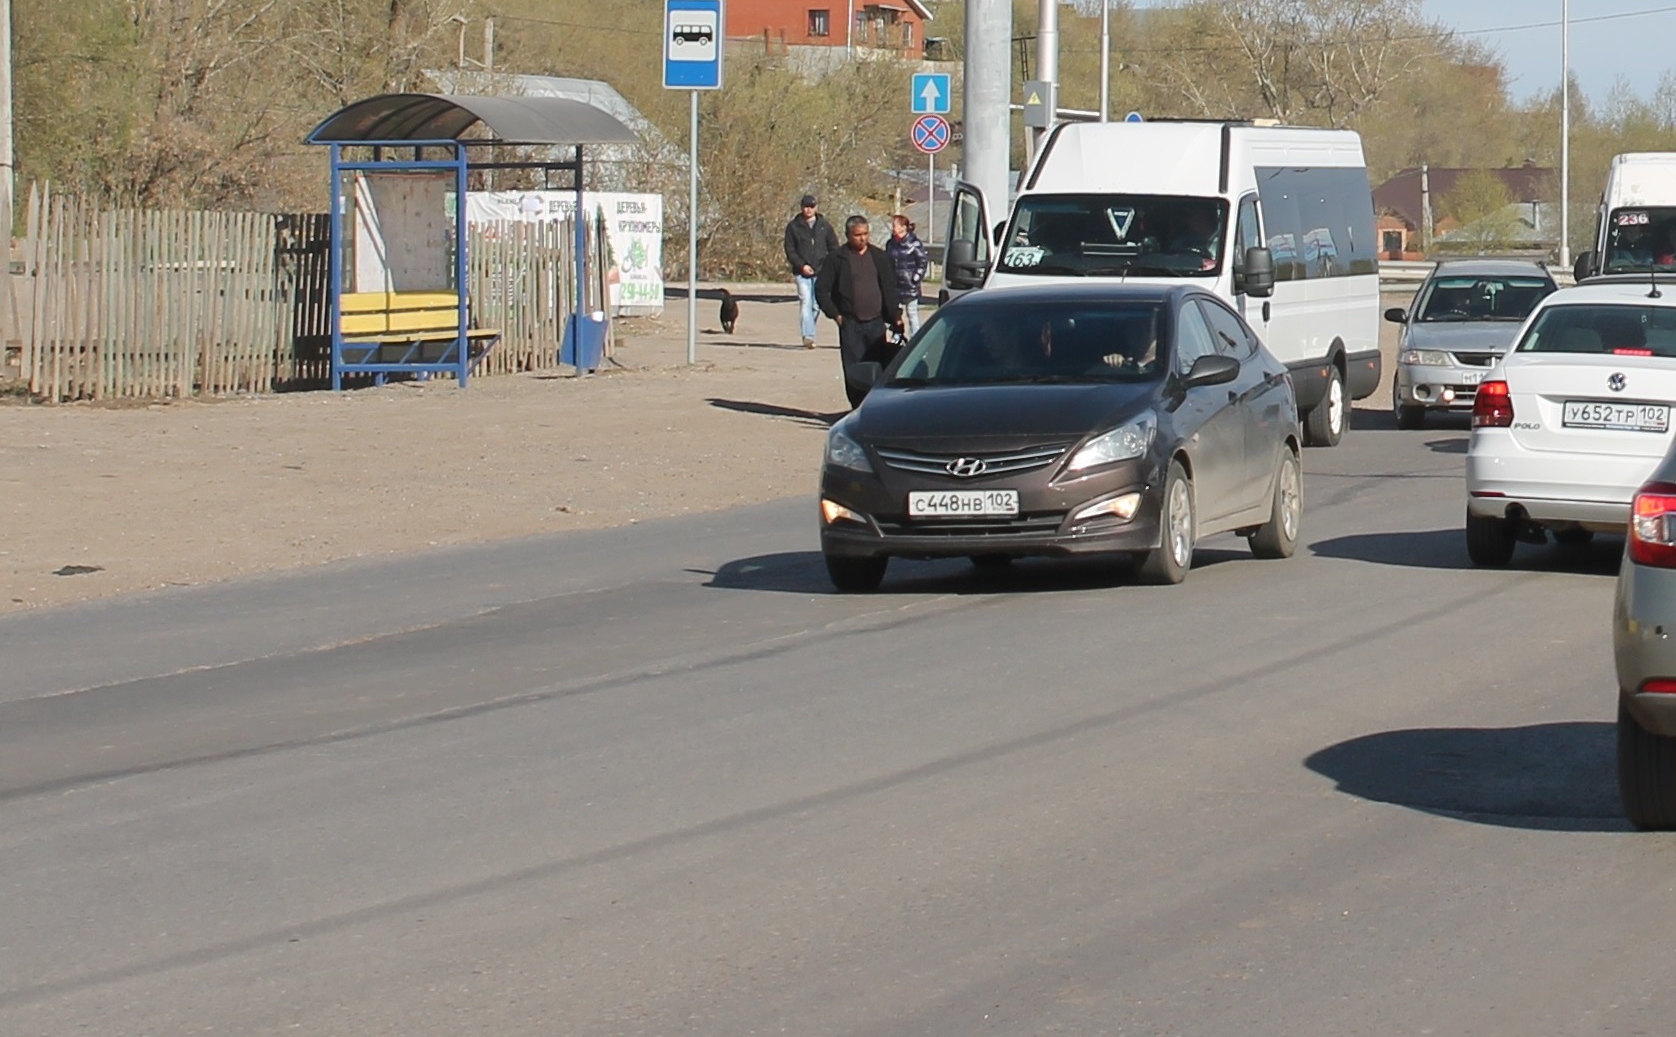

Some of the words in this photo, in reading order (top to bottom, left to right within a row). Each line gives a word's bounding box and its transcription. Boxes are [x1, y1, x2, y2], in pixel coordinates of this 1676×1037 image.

[1618, 213, 1649, 226] 236
[1571, 404, 1636, 424] У652ТР
[1640, 406, 1664, 420] 102
[1514, 422, 1541, 430] POLO
[915, 494, 983, 512] С448НВ
[987, 492, 1013, 506] 102
